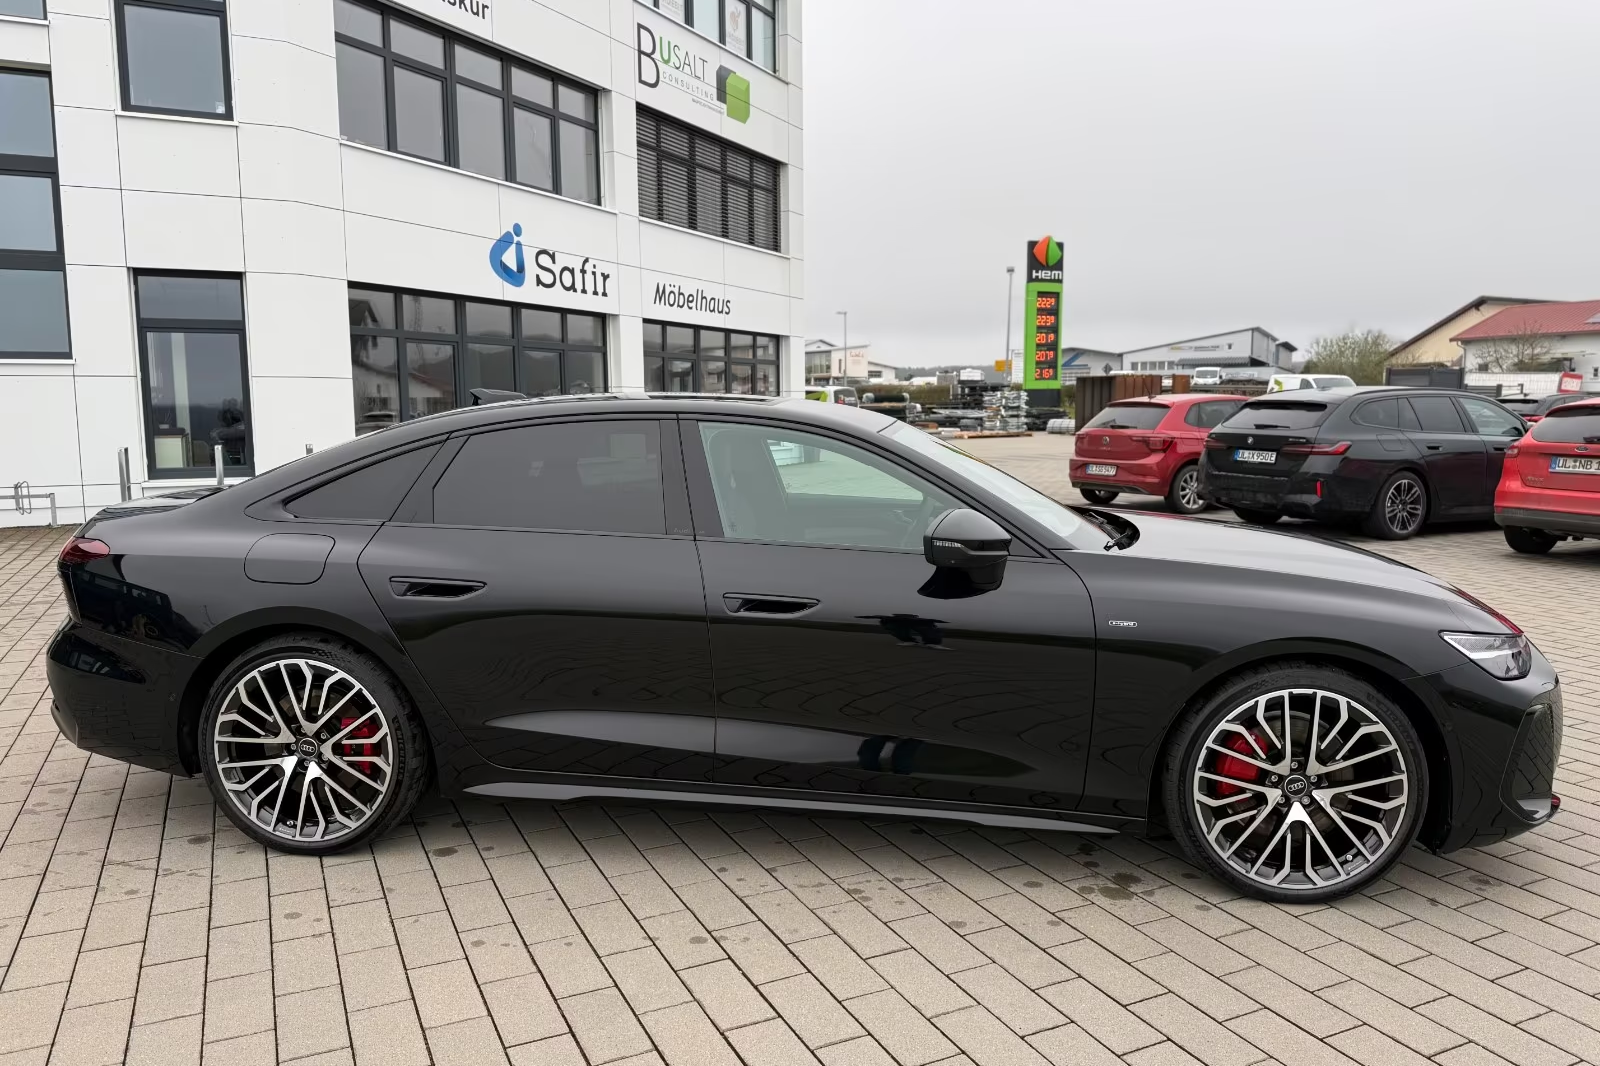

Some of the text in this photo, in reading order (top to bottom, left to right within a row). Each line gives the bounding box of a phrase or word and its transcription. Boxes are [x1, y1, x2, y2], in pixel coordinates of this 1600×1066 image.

[637, 22, 708, 88] BUSALT
[663, 71, 714, 101] CONSULTING
[535, 249, 610, 297] Safir
[654, 282, 731, 315] Möbelhaus
[1558, 458, 1571, 469] UL
[1578, 459, 1593, 470] NB
